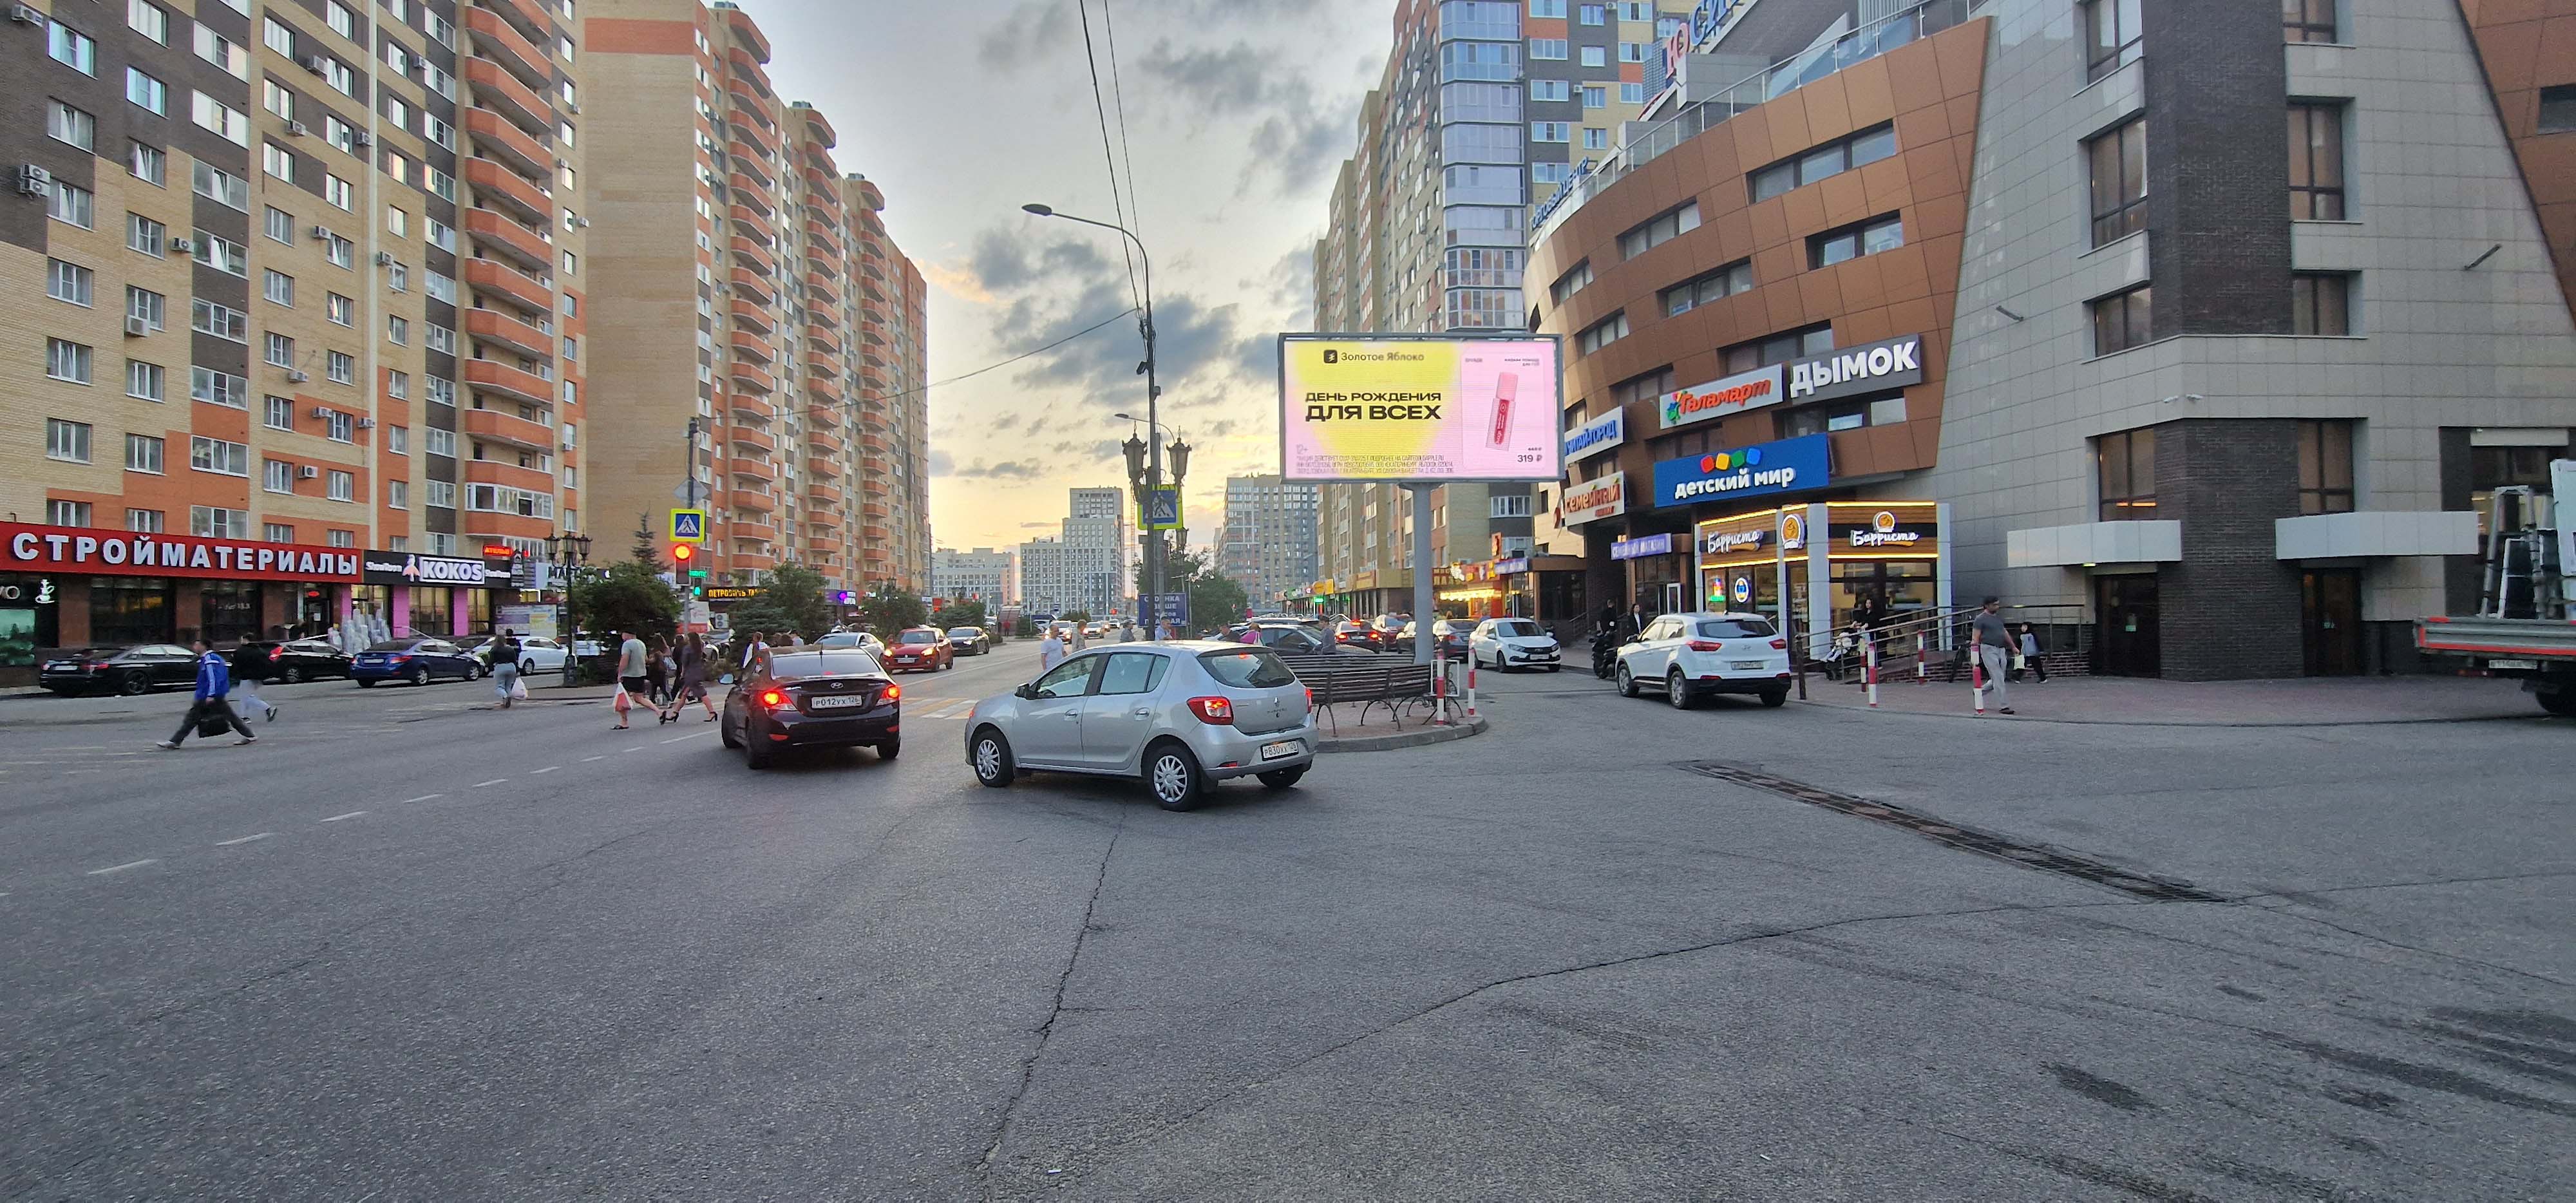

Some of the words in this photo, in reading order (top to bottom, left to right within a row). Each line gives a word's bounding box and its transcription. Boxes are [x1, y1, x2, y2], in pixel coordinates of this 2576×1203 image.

[1341, 352, 1384, 361] Золотое
[1387, 351, 1425, 361] Яблоко
[1790, 341, 1918, 399] ДЫМОК
[1305, 392, 1347, 403] ДЕНЬ
[1351, 392, 1441, 403] РОЖДЕНИЯ
[1680, 379, 1772, 415] Галамарт
[1305, 405, 1362, 422] ДЛЯ
[1369, 405, 1442, 420] ВСЕХ
[1674, 468, 1751, 500] детский
[1754, 467, 1797, 488] мир
[1707, 530, 1762, 554] Барриста
[1852, 529, 1919, 547] Барриста
[13, 532, 357, 575] СТРОЙМАТЕРИАЛЫ
[422, 560, 483, 581] KOKOS
